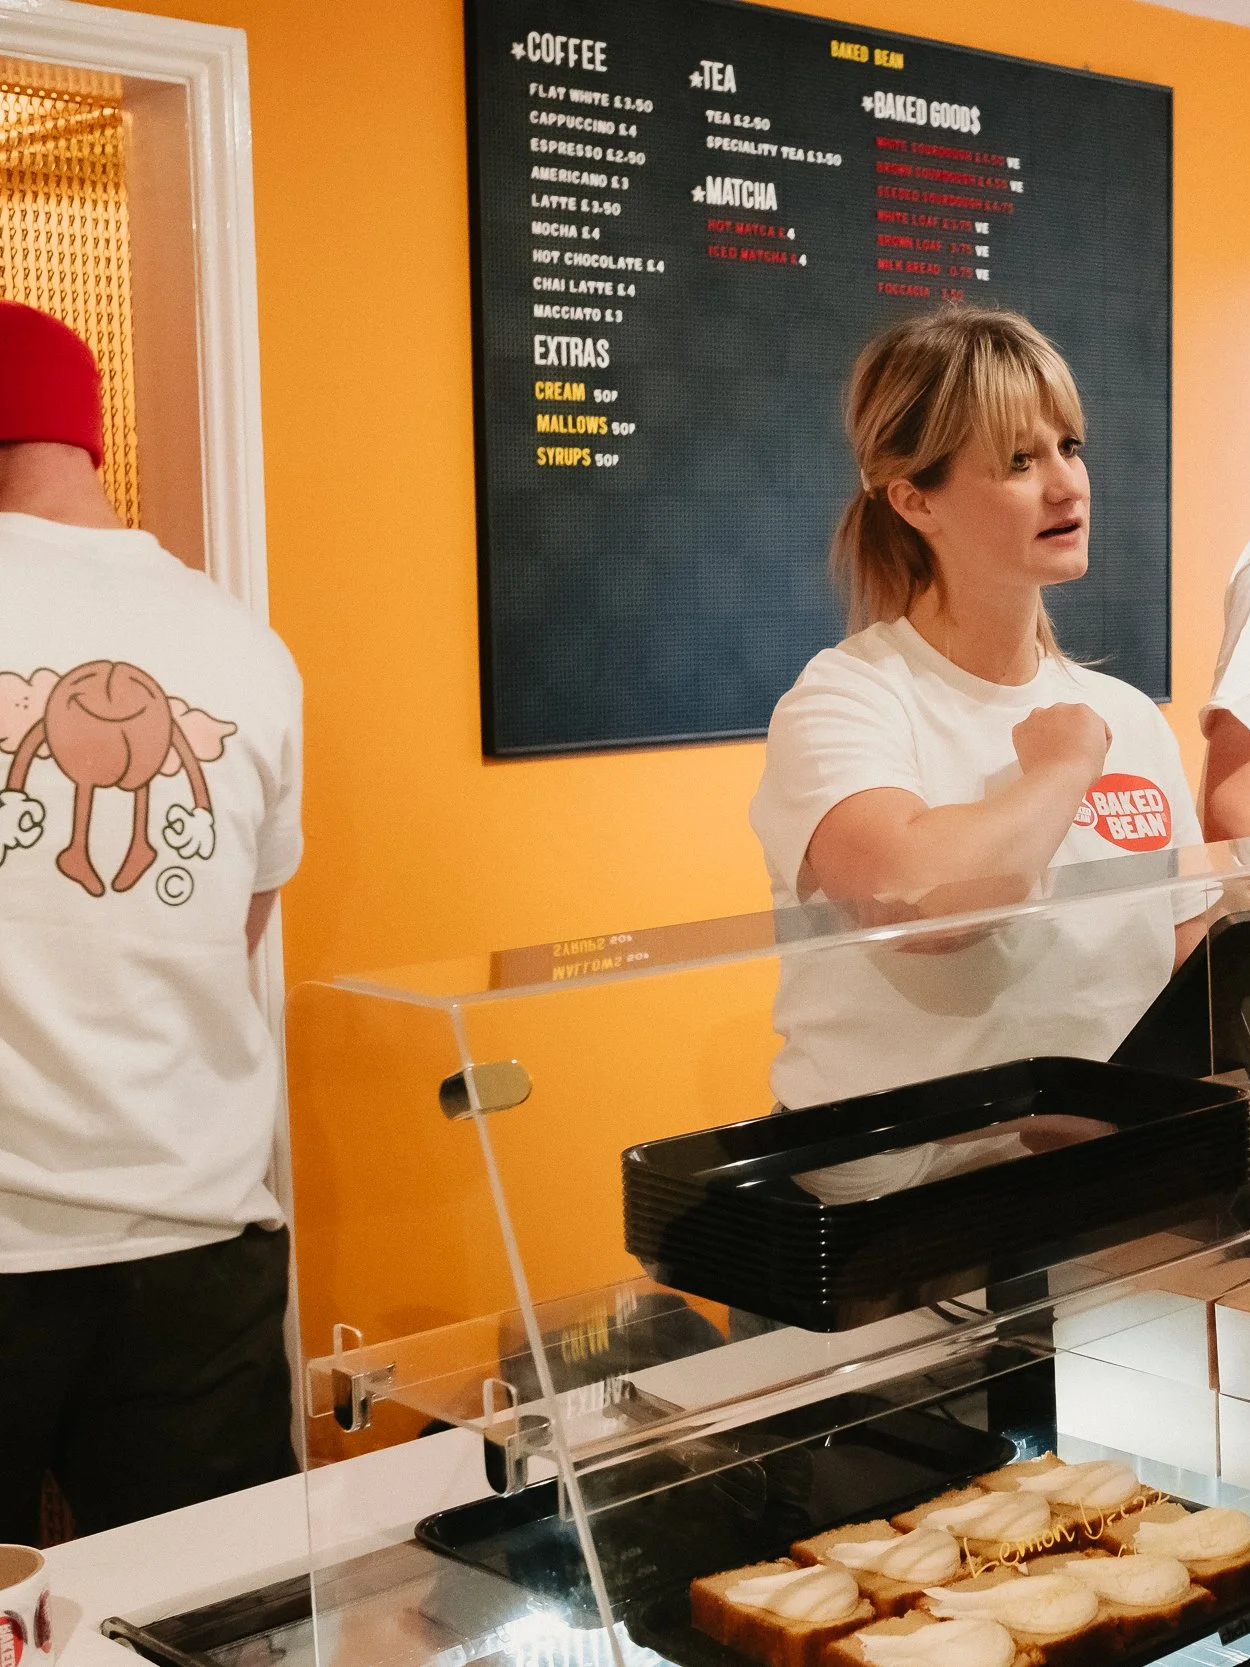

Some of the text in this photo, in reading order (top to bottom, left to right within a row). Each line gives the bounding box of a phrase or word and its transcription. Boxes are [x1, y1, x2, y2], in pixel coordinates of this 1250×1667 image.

[527, 31, 608, 72] COFFEE
[831, 40, 904, 70] BAKED BEAN
[700, 60, 737, 93] TEA
[529, 82, 566, 100] FLAT
[569, 88, 610, 107] WHITE
[705, 109, 771, 131] TEA £2.50
[874, 90, 927, 125] BAKED
[530, 110, 637, 138] CAPPUCCINO £4
[530, 137, 646, 165] ESPRESSO £2.50
[706, 136, 779, 157] SPECIALITY
[781, 146, 805, 162] TEA
[531, 166, 608, 188] AMERICANO
[531, 193, 577, 211] LATTE
[706, 175, 778, 211] MATCHA
[532, 221, 600, 240] MOCHA £4
[707, 219, 731, 232] HOT
[533, 249, 665, 273] HOT CHOCOLATE £4
[533, 276, 636, 298] CHAI LATTE £4
[533, 304, 602, 322] MACCIATO
[534, 335, 610, 369] EXTRAS
[535, 380, 586, 401] CREAM
[536, 414, 608, 435] MALLOWS
[537, 446, 592, 467] SYRUPS
[1091, 789, 1164, 816] BAKED
[963, 1523, 1075, 1578] Lemon
